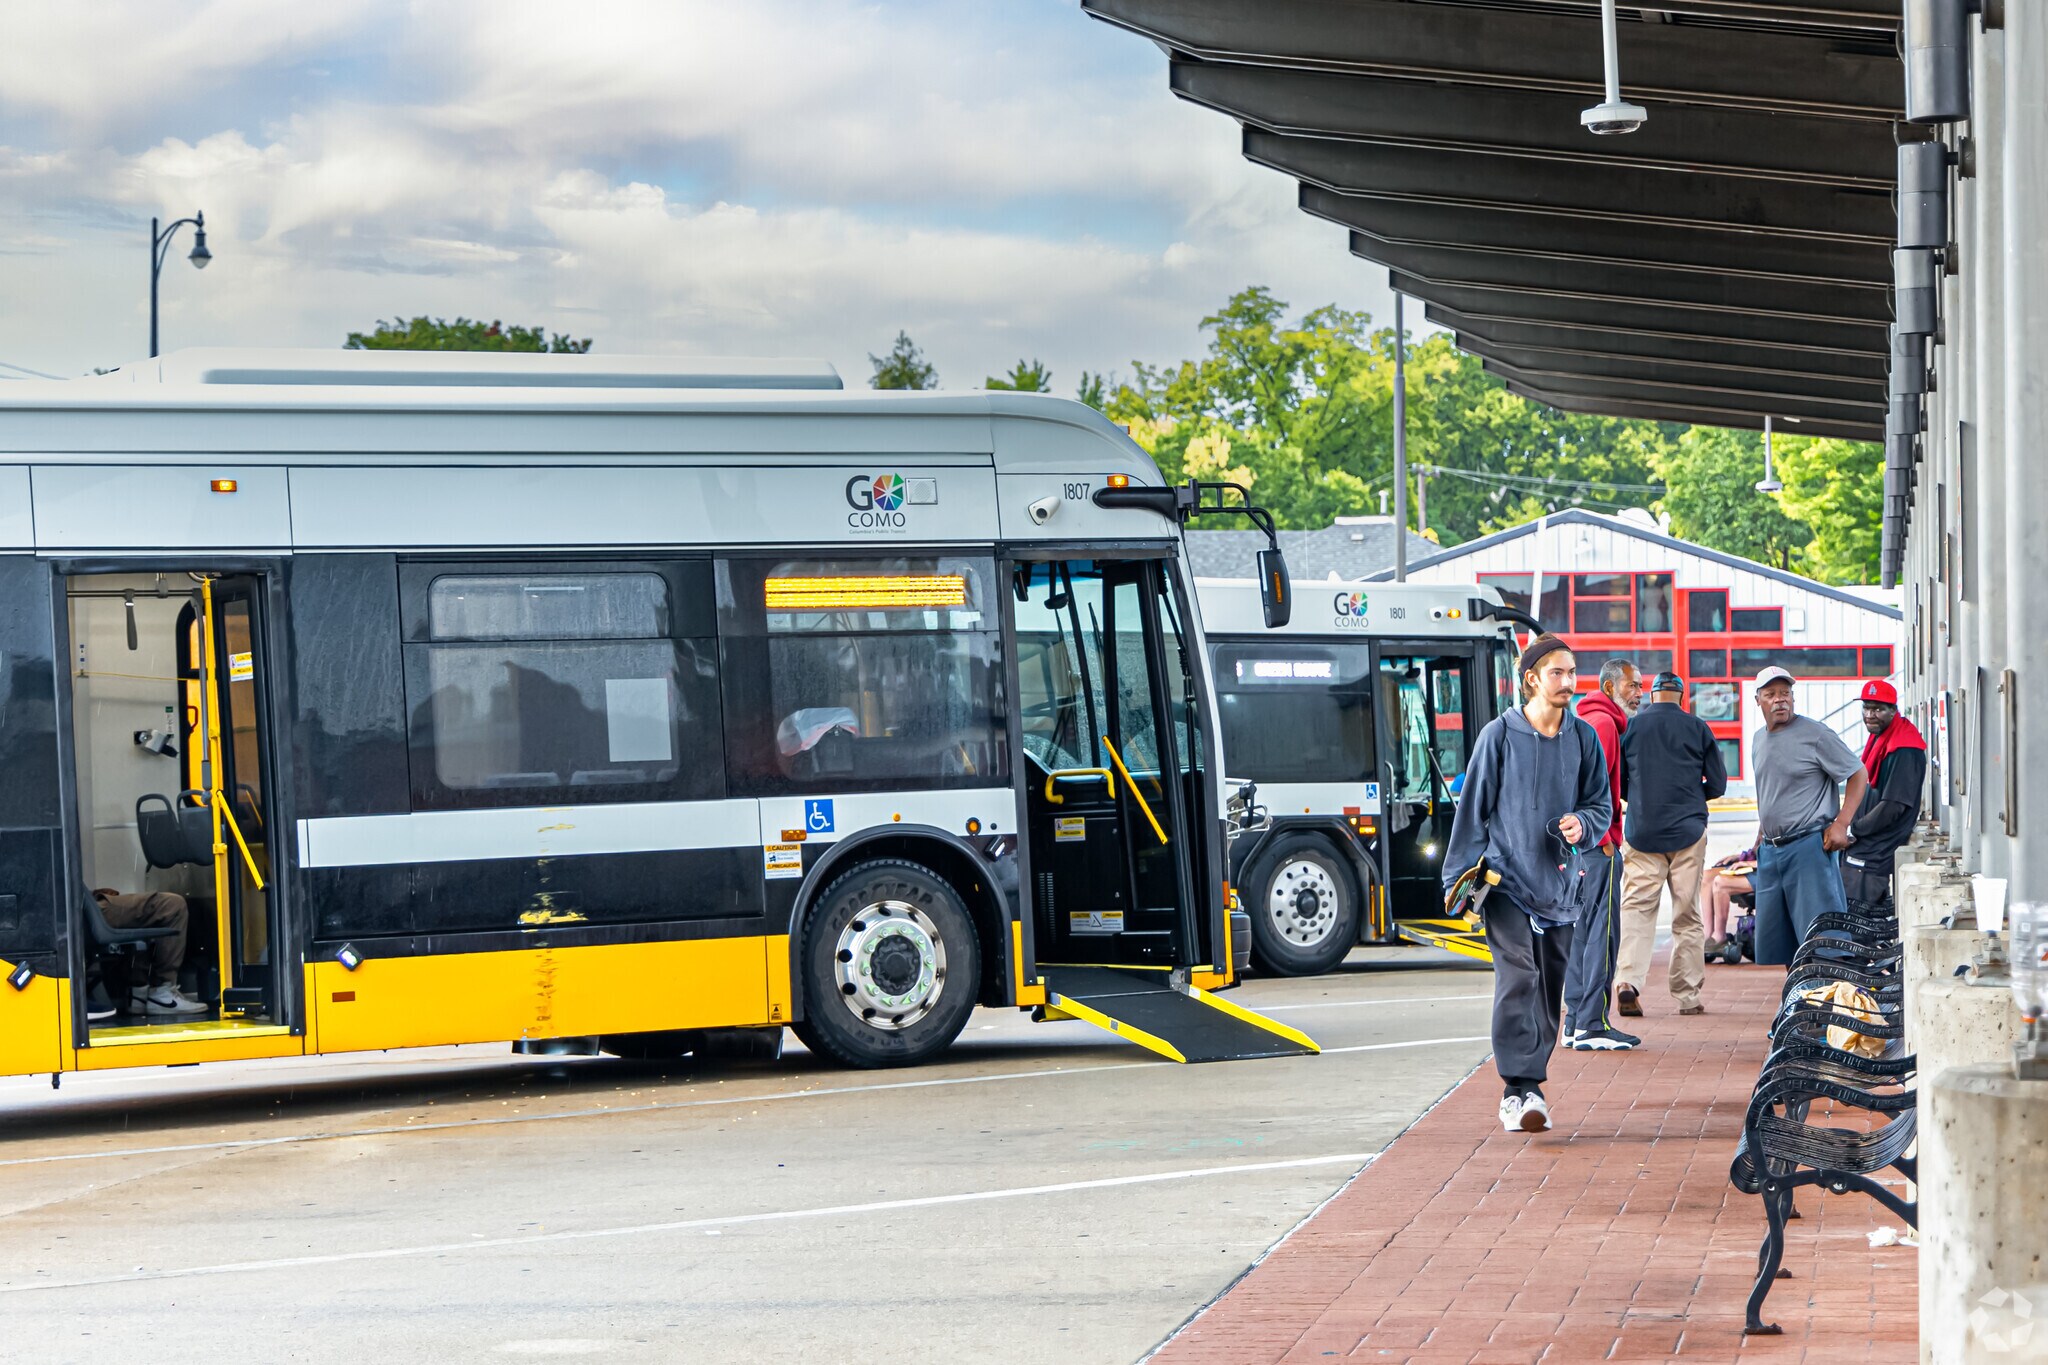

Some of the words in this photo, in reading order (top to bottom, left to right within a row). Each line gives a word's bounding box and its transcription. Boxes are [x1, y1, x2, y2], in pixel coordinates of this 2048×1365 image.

[846, 472, 905, 511] GO
[1063, 482, 1091, 501] 1807
[848, 512, 906, 528] COMO
[1334, 592, 1368, 617] GO
[1389, 607, 1406, 620] 1801
[1334, 617, 1369, 628] COMO
